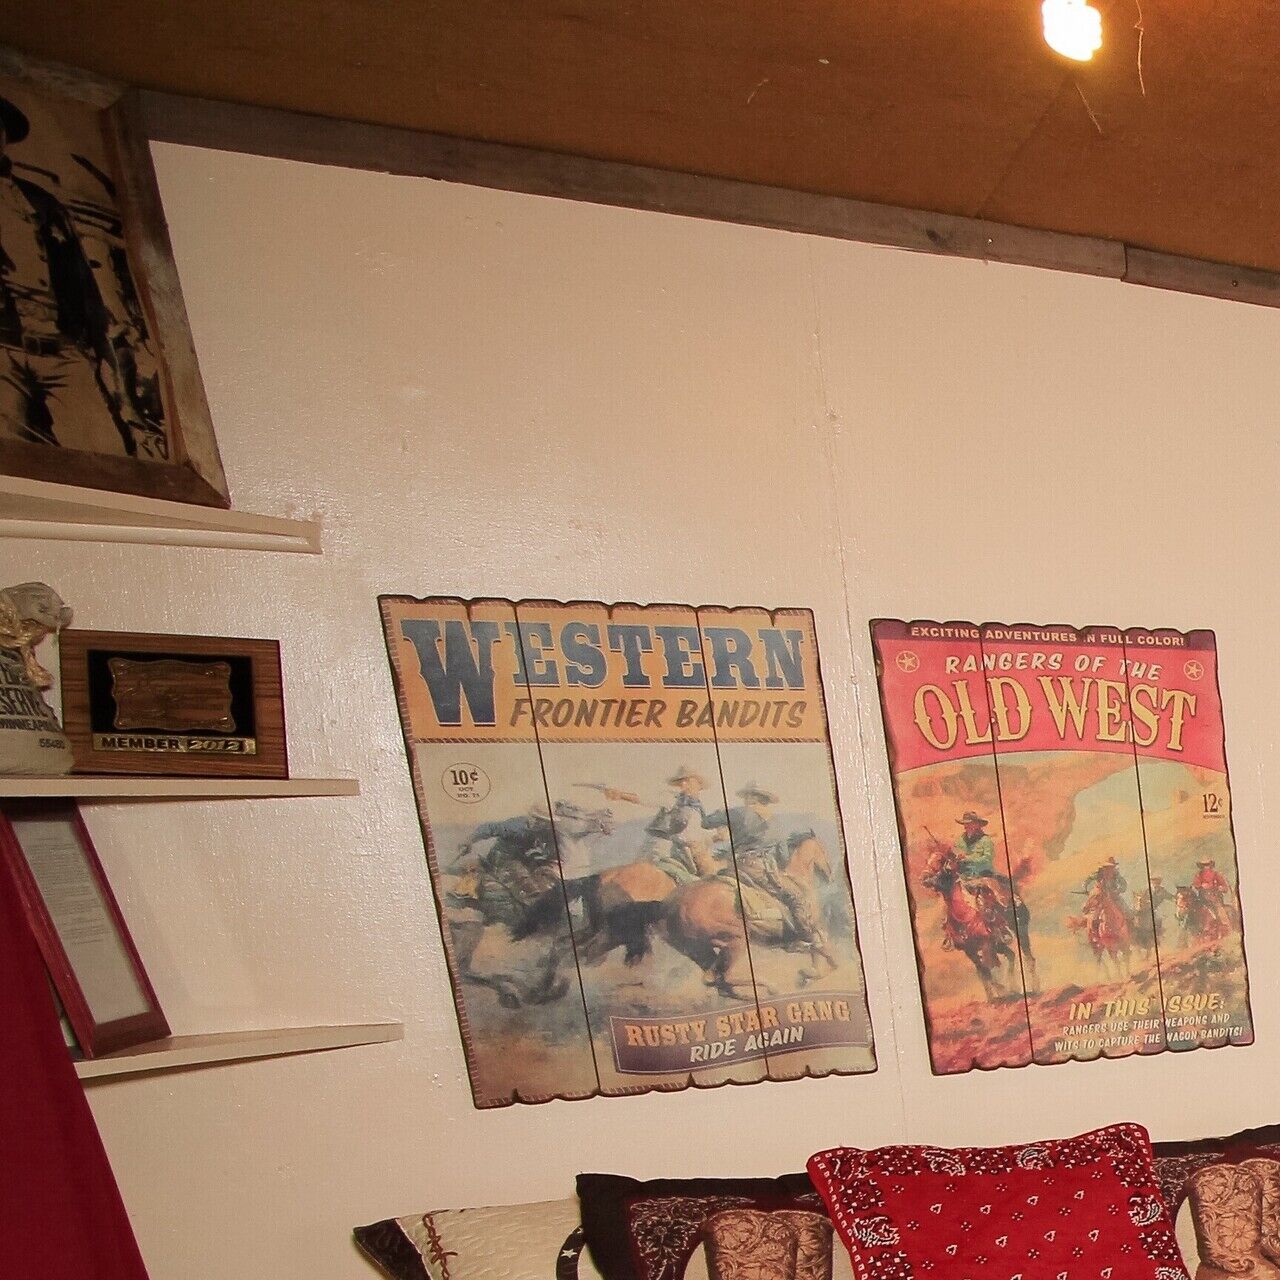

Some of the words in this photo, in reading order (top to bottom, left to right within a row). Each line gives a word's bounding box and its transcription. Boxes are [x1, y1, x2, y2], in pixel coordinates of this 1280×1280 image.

[911, 627, 980, 639] EXCITING
[985, 630, 1077, 642] ADVENTURES
[1101, 633, 1133, 645] FULL
[1137, 635, 1185, 646] COLOR!
[400, 618, 806, 728] WESTERN
[945, 652, 1063, 675] RANGERS
[1074, 655, 1107, 673] OF
[1119, 659, 1162, 680] THE
[509, 698, 667, 729] FRONTIER
[676, 699, 807, 729] BANDITS
[913, 676, 1032, 750] OLD
[1037, 675, 1197, 751] WEST
[101, 736, 180, 750] MEMBER
[187, 739, 241, 751] 2012
[624, 1020, 706, 1047] RUSTY
[716, 1006, 780, 1037] STAR
[786, 1000, 851, 1024] GANG
[1069, 1002, 1093, 1021] IN
[1103, 998, 1150, 1019] THIS
[1063, 1022, 1107, 1036] RANGERS
[1111, 1021, 1130, 1032] USE
[1133, 1019, 1160, 1030] THEIR
[1210, 1013, 1230, 1024] AND
[690, 1038, 735, 1063] RIDE
[744, 1026, 804, 1052] AGAIN
[1054, 1040, 1079, 1052] WITS
[1083, 1038, 1096, 1049] TO
[1098, 1036, 1140, 1049] CAPTURE
[1144, 1033, 1161, 1044] THE
[1200, 1026, 1244, 1039] BANDITS!
